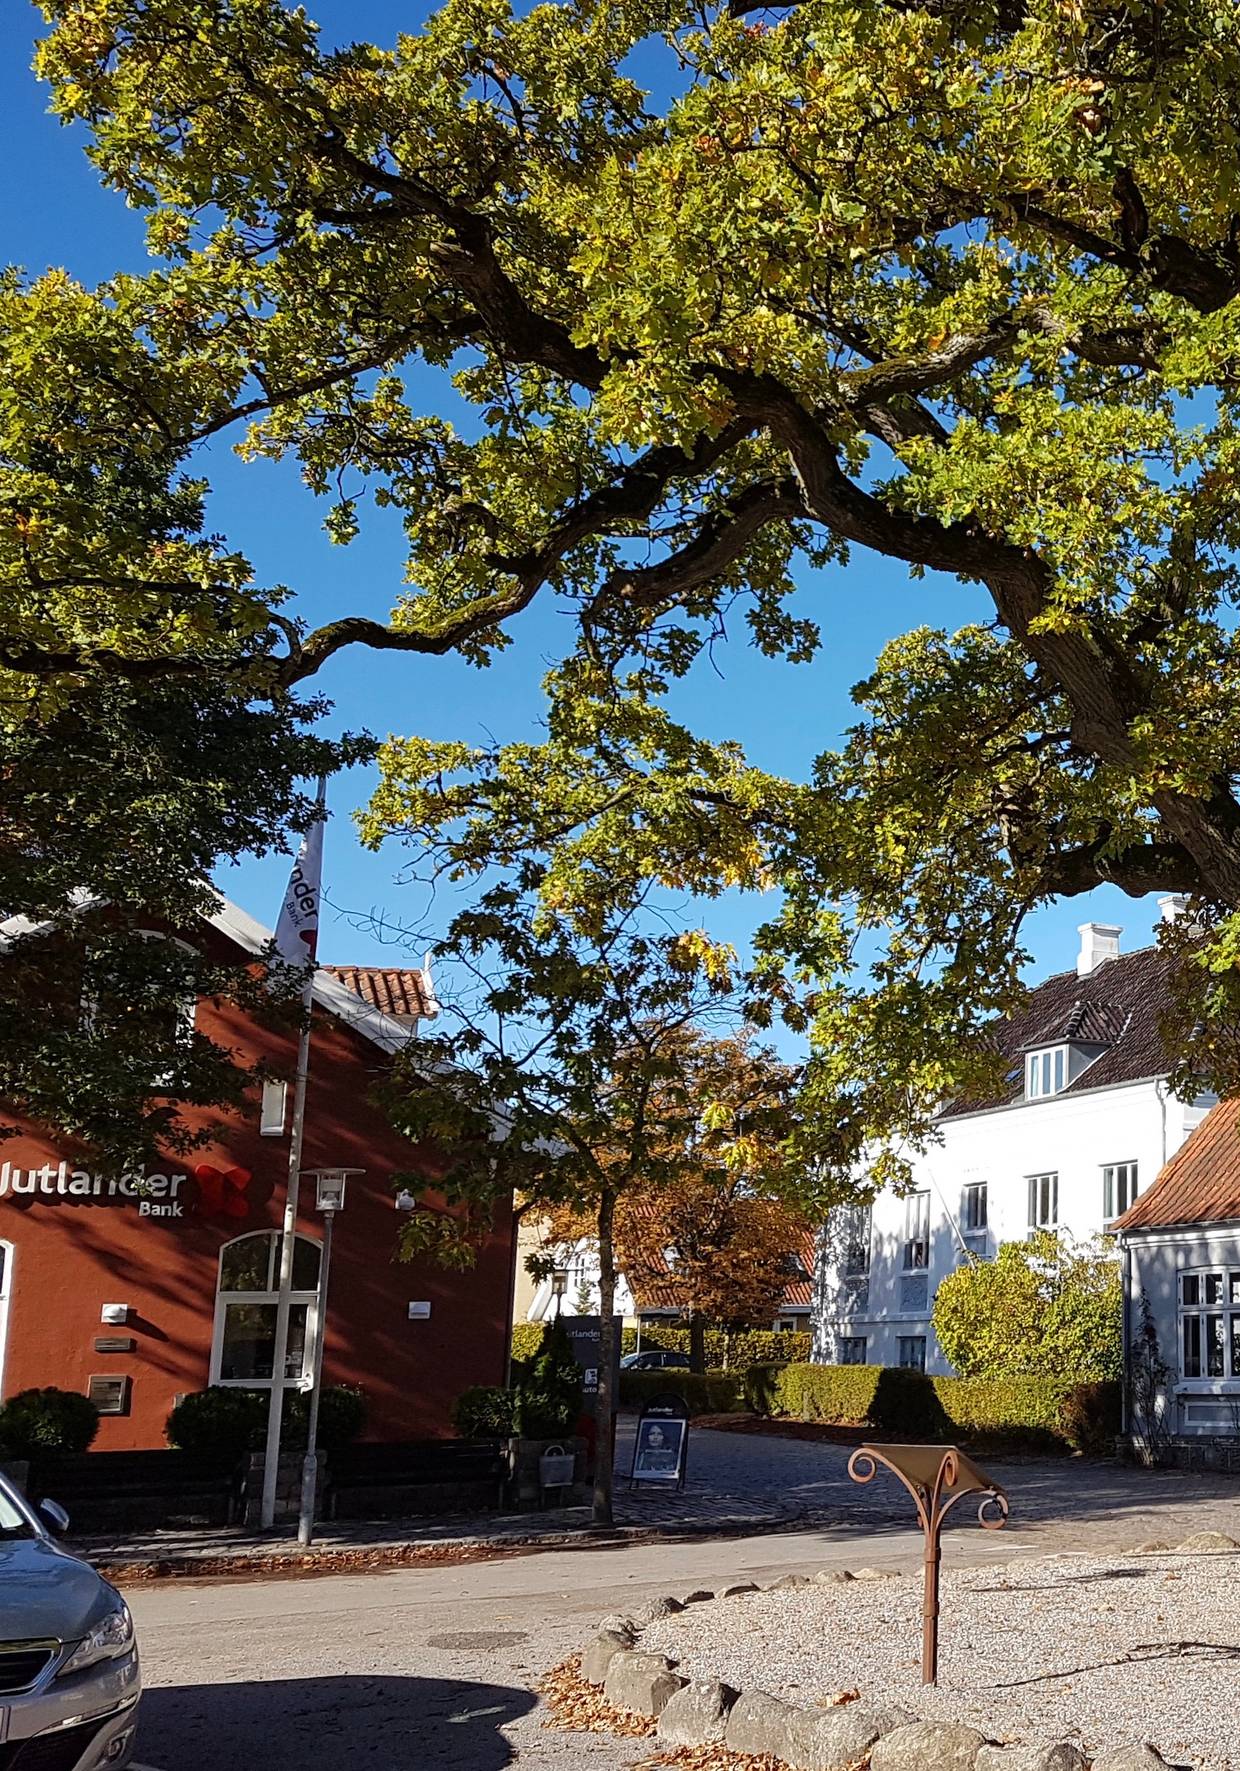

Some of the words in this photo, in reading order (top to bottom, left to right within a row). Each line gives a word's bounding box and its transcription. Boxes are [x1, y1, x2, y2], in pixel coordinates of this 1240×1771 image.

[286, 901, 302, 928] Bank
[0, 1160, 187, 1198] Jutlander
[138, 1201, 184, 1217] Bank
